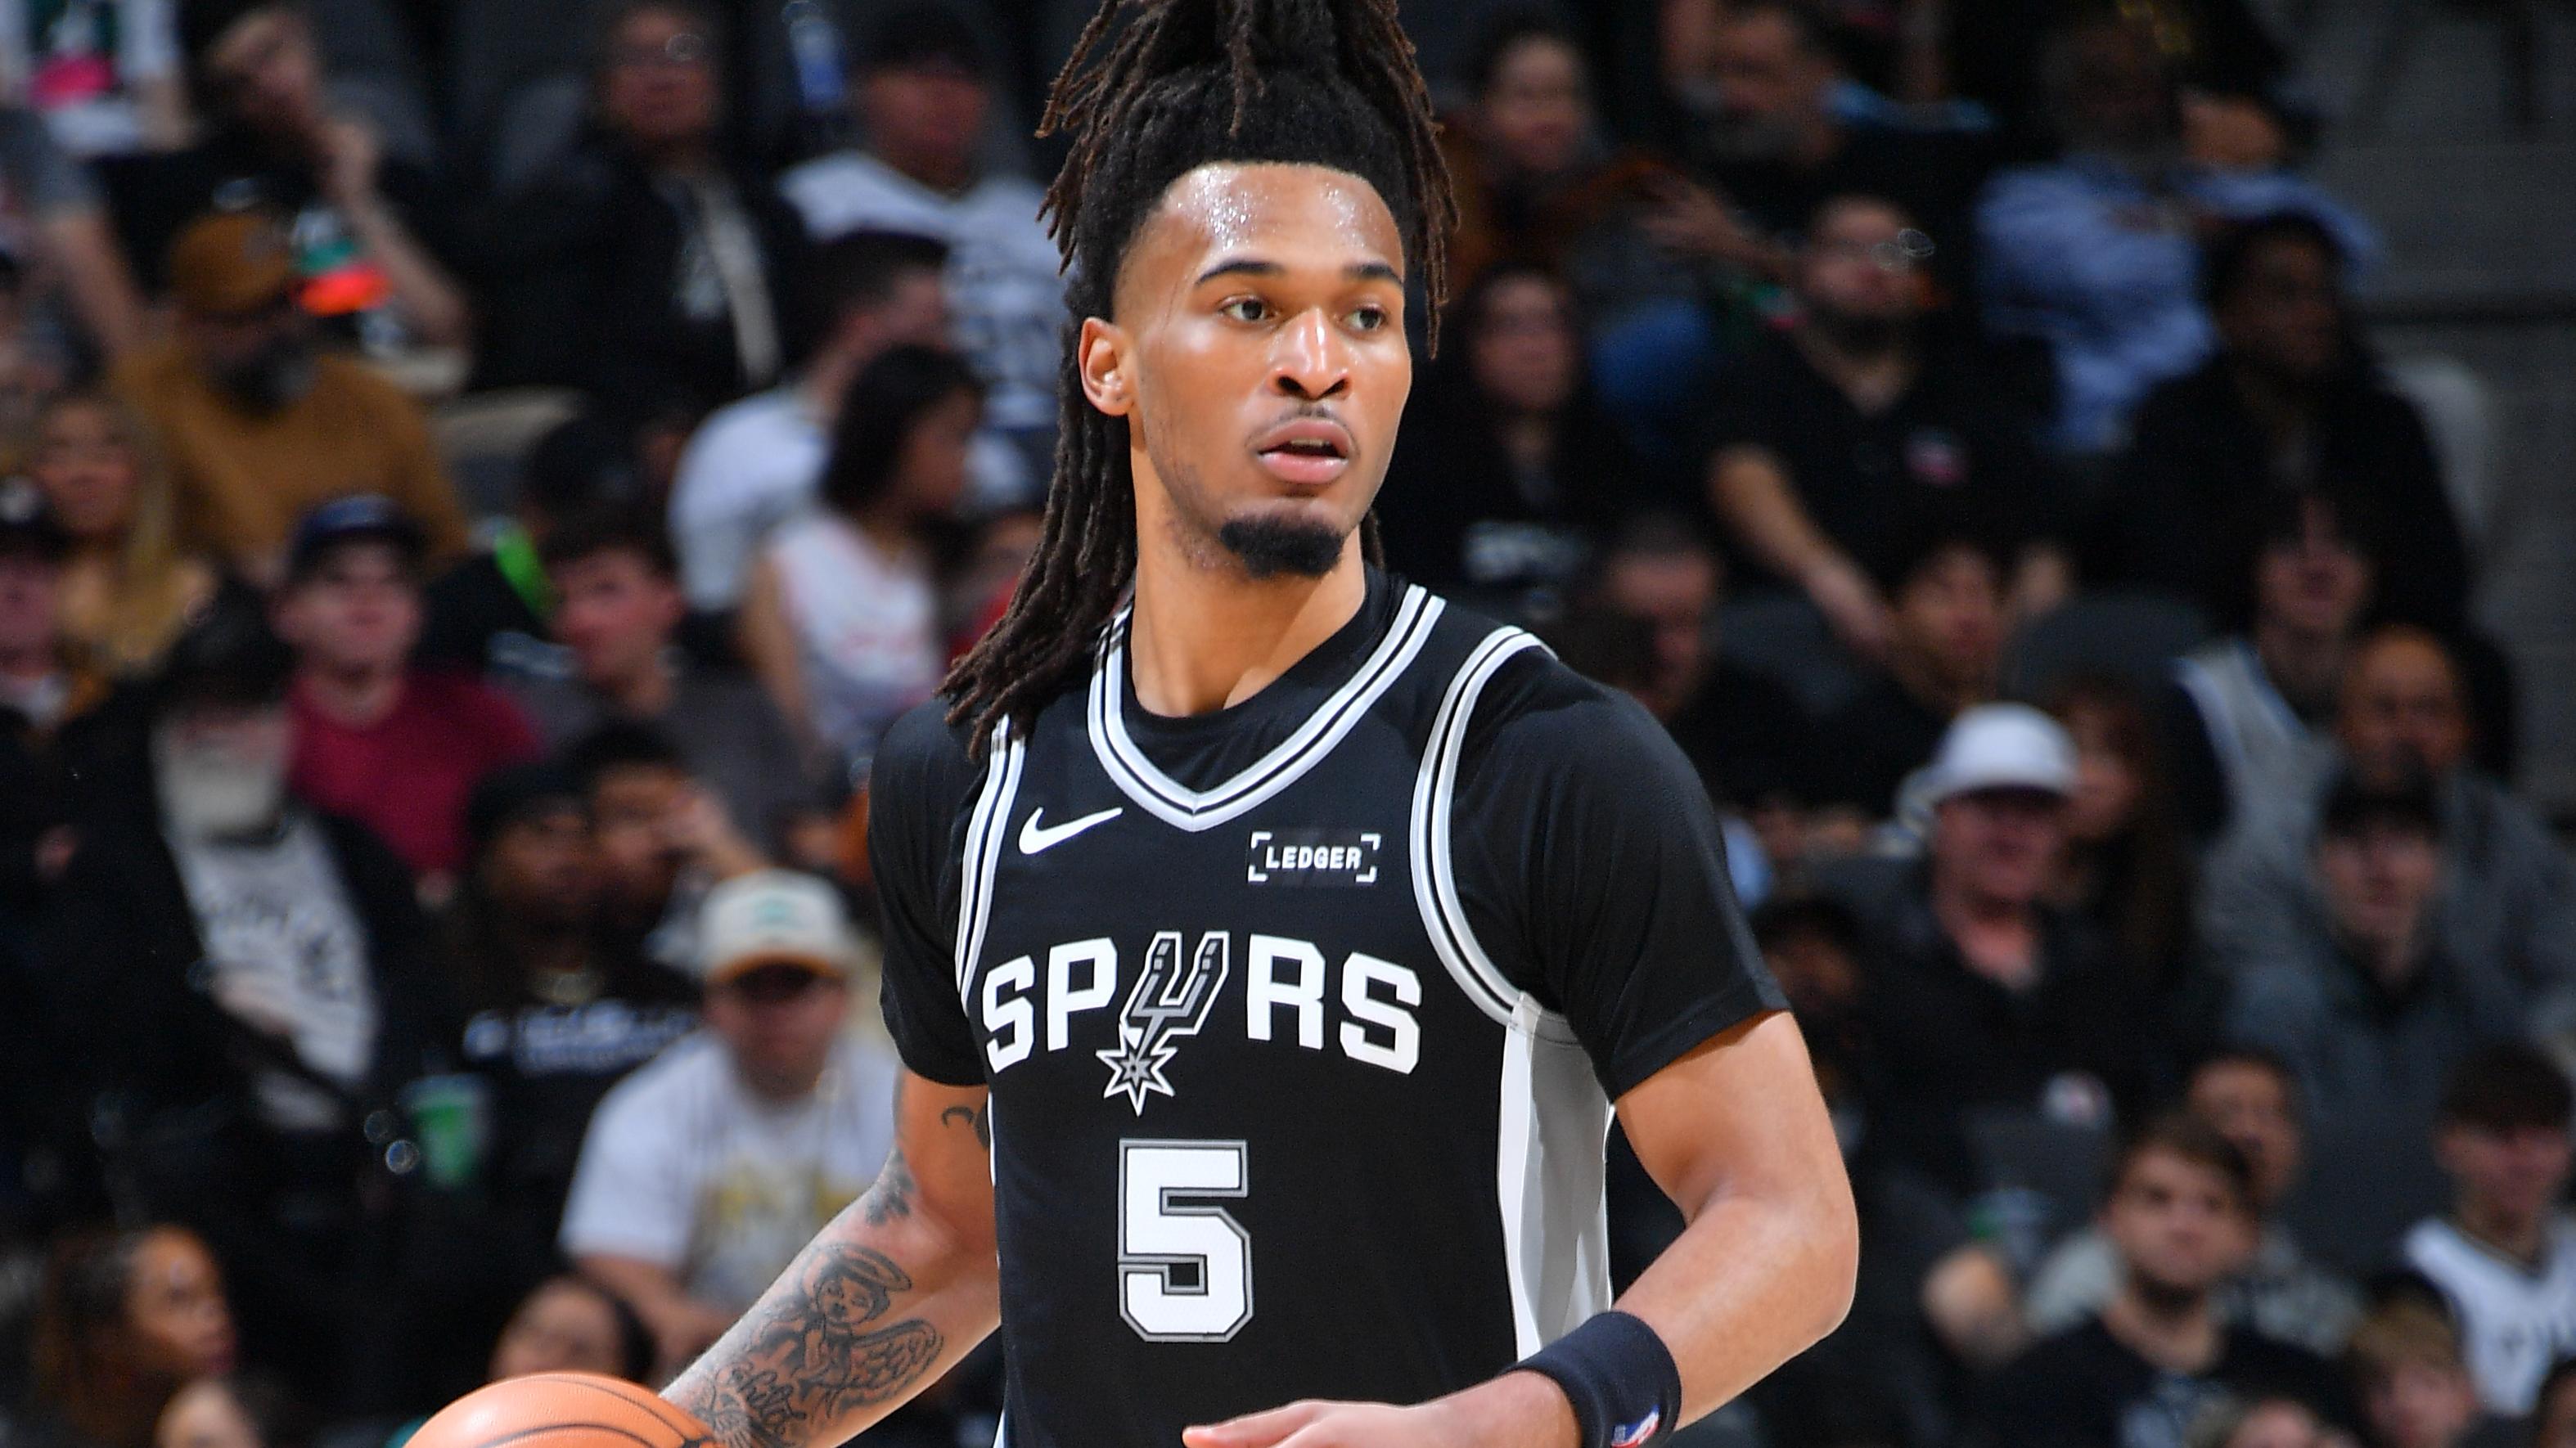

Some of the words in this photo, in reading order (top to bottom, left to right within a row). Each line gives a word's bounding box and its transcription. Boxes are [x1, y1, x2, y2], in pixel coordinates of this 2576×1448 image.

[1266, 846, 1362, 870] LEDGER
[982, 931, 1422, 1117] SPURS
[1118, 1138, 1254, 1343] 5
